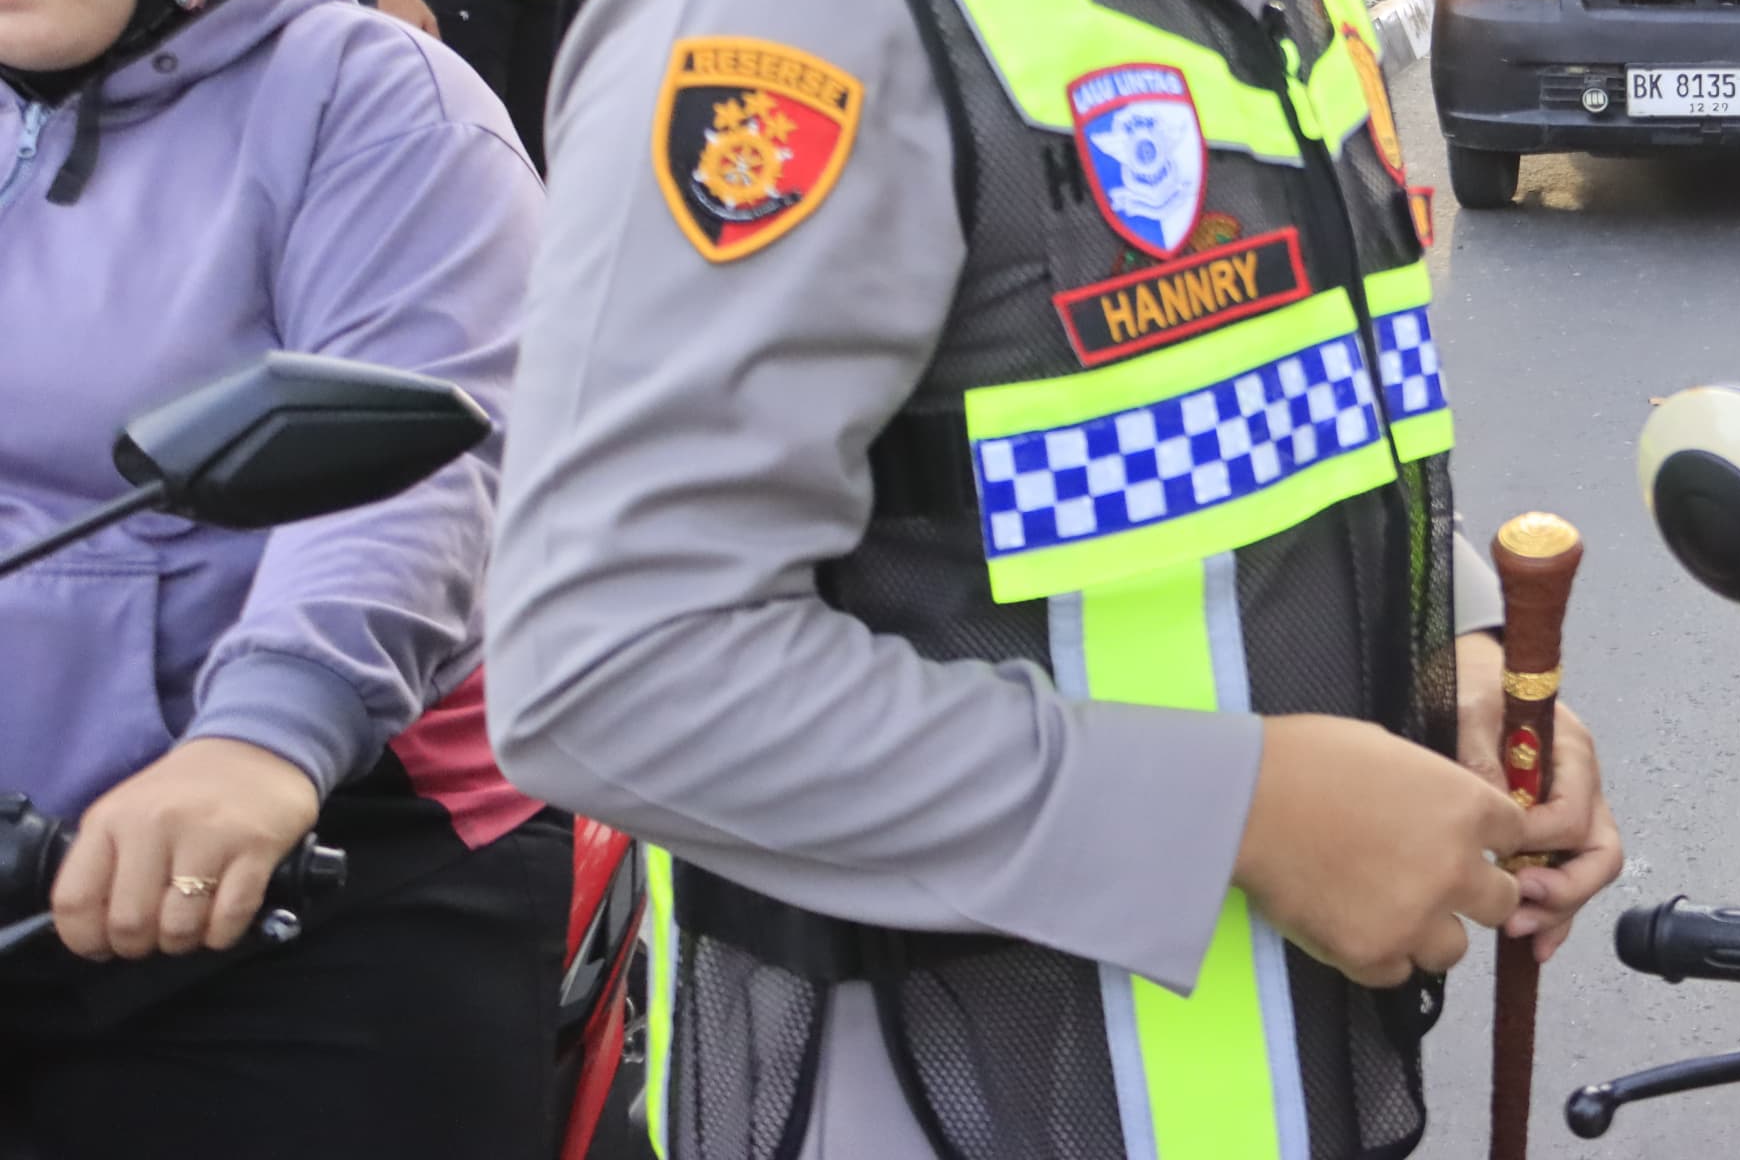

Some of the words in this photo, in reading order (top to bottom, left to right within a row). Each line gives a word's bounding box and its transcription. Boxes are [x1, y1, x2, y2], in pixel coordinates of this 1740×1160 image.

[698, 48, 848, 105] RESERSE
[1633, 73, 1663, 98] BK
[1676, 73, 1736, 98] 8135
[1690, 102, 1704, 113] 12
[1101, 250, 1259, 343] HANNRY
